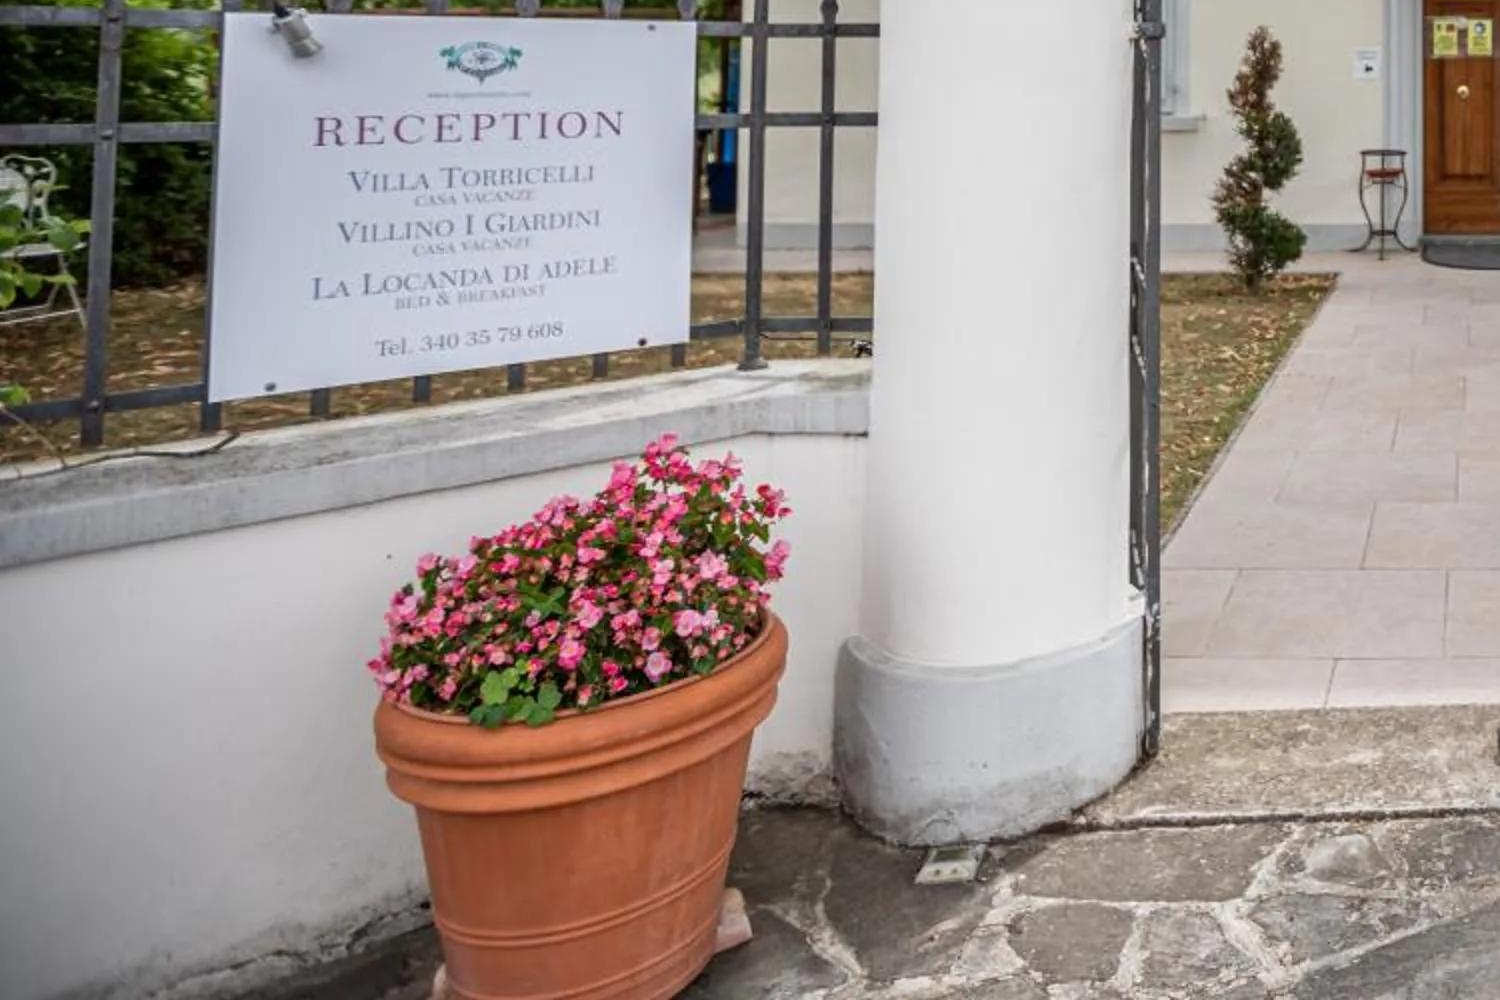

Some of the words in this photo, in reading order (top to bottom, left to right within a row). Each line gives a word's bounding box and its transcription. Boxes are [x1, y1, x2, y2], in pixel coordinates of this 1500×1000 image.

[312, 110, 625, 147] RECEPTION
[347, 170, 430, 193] VILLA
[440, 164, 595, 190] TORRICELLI
[413, 194, 456, 207] CASA
[337, 218, 455, 244] VILLINO
[466, 213, 475, 236] I
[484, 209, 601, 234] GIARDINI
[411, 241, 456, 257] CASA
[312, 276, 351, 301] LA
[362, 264, 494, 297] LOCANDA
[503, 262, 530, 284] DI
[540, 254, 618, 281] ADELE
[394, 294, 432, 311] BED
[436, 292, 450, 306] &
[457, 284, 549, 305] BREAKFAST
[375, 338, 413, 358] Tel.
[420, 331, 461, 352] 340
[466, 328, 492, 347] 35
[498, 324, 522, 343] 79
[527, 320, 565, 339] 608
